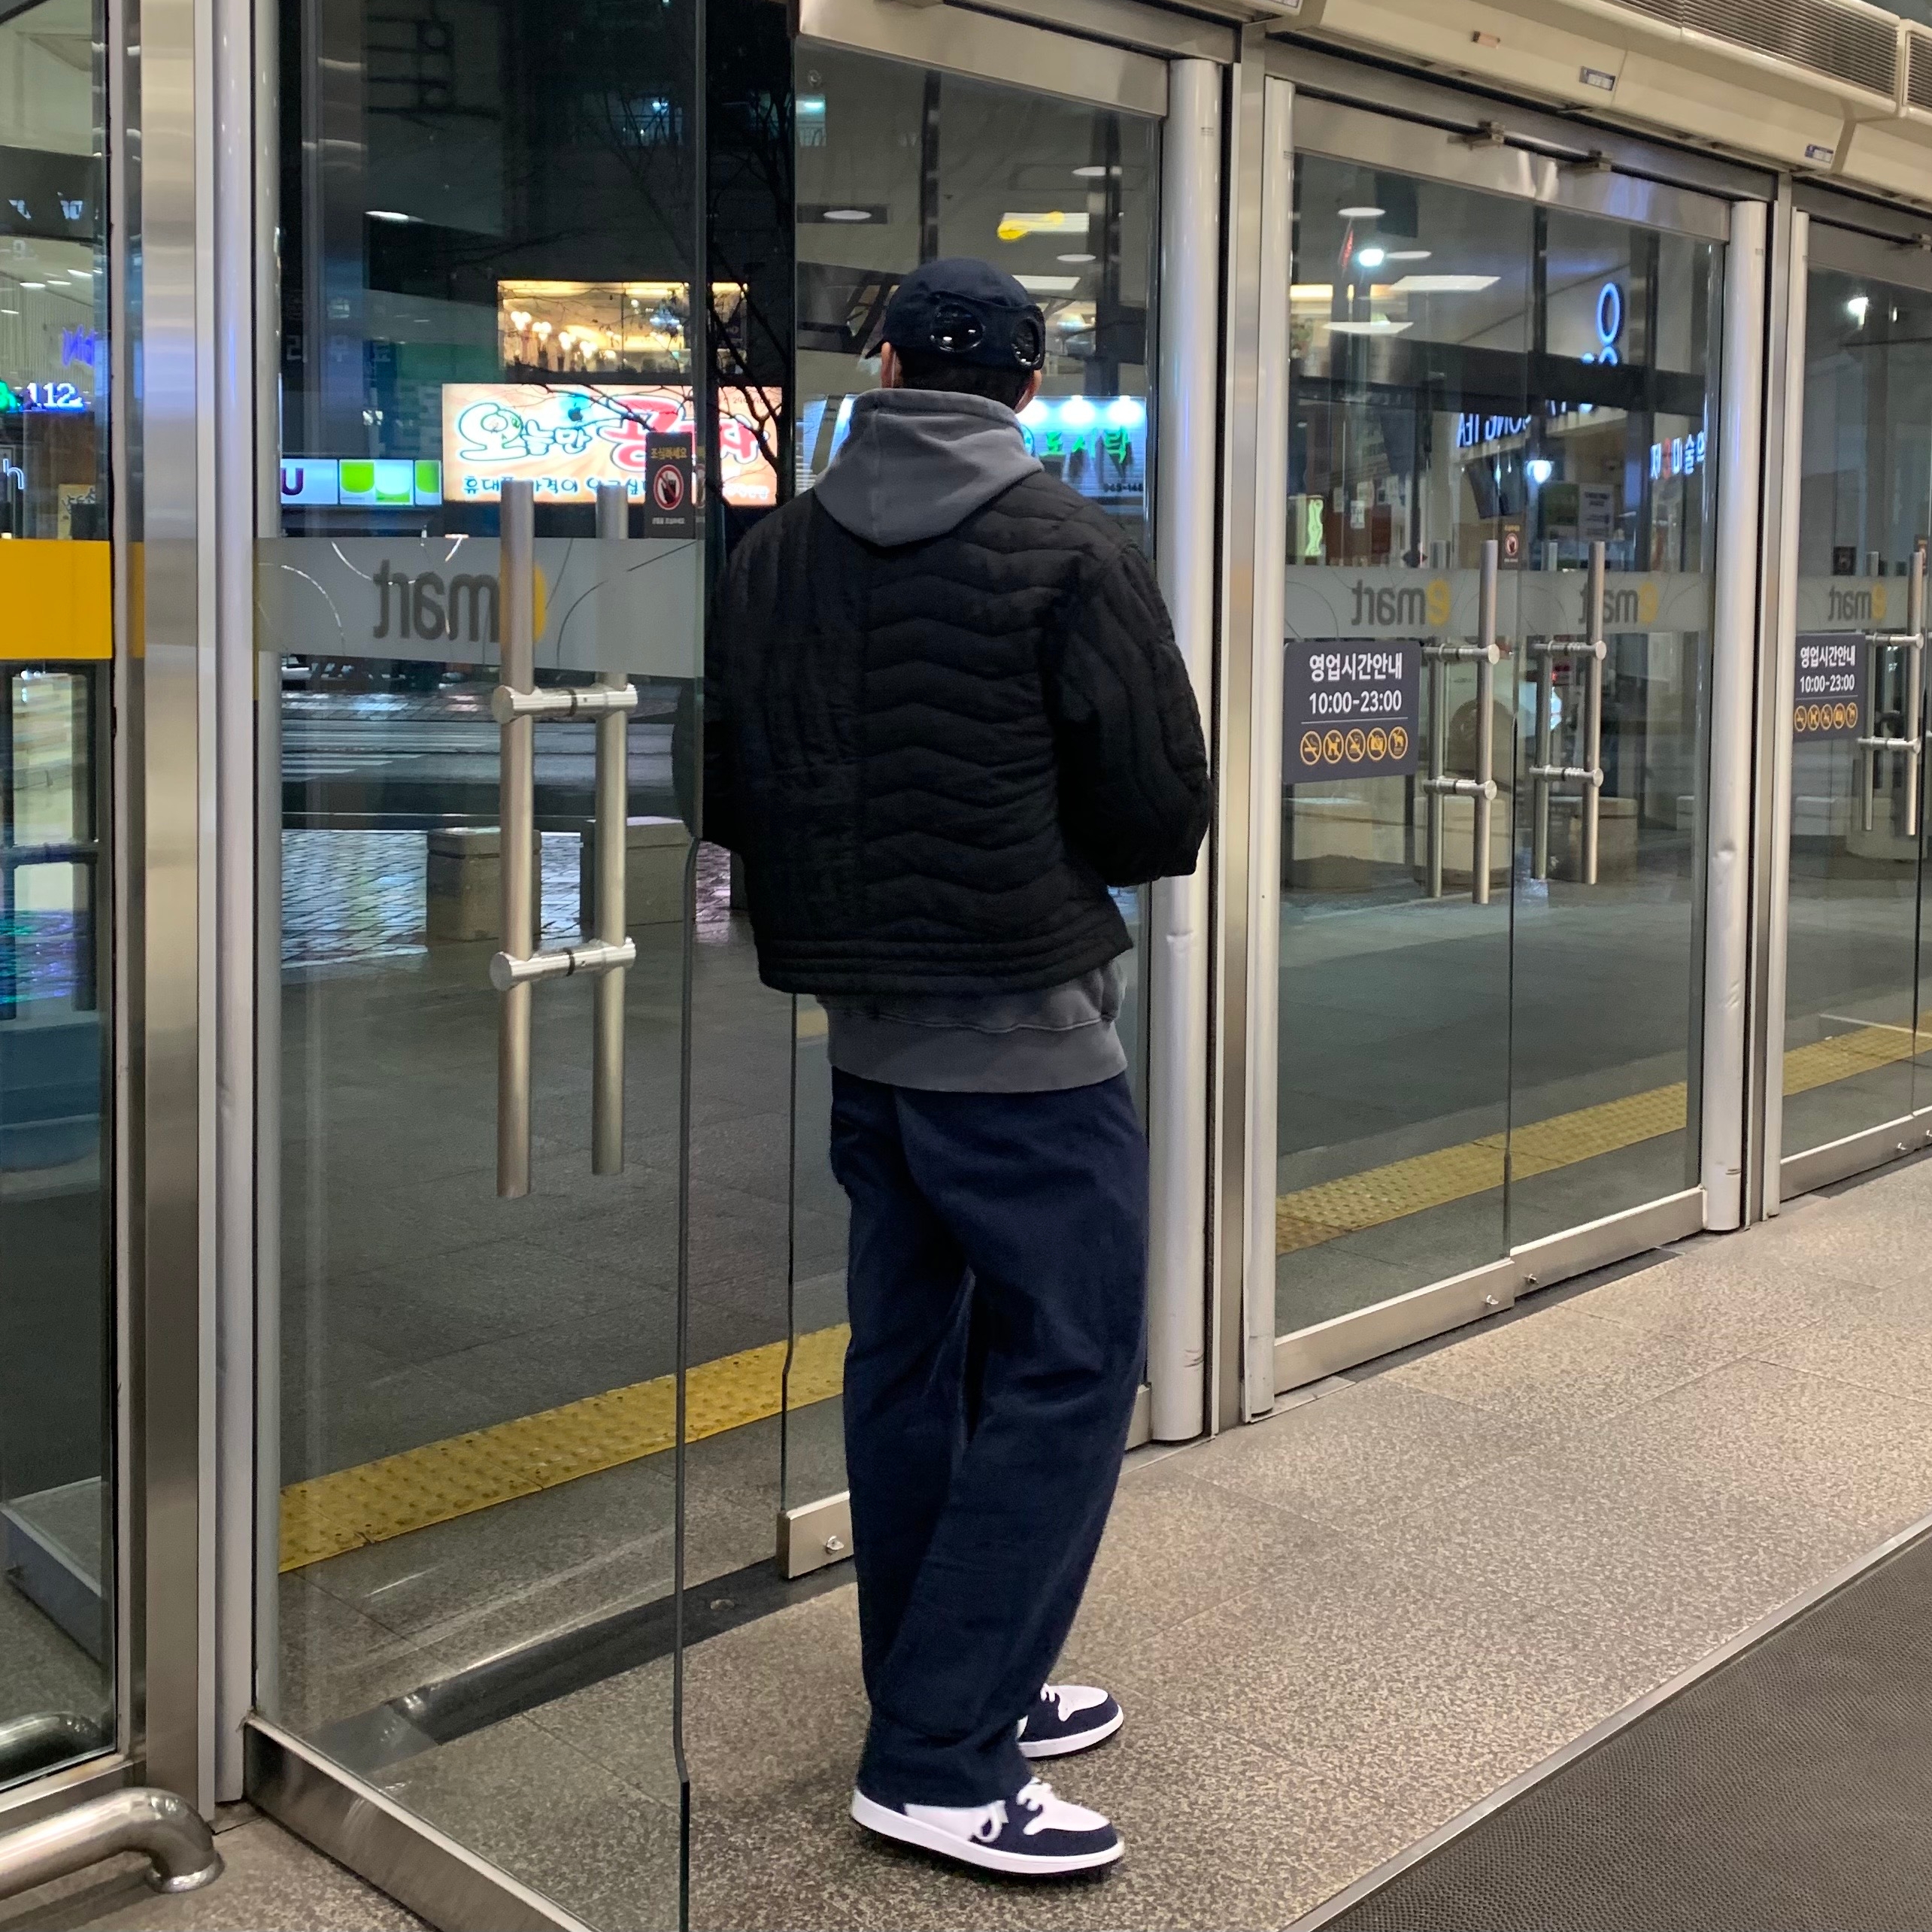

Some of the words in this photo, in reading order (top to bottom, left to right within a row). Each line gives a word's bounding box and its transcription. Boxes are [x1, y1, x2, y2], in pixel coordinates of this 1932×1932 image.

[458, 402, 593, 461] 오늘만
[463, 476, 514, 494] 휴대
[1309, 652, 1403, 682] 영업시간안내
[1800, 645, 1856, 669] 영업시간안내
[1800, 674, 1855, 693] 10:00-23:00
[1309, 690, 1403, 714] 10:00-23:00
